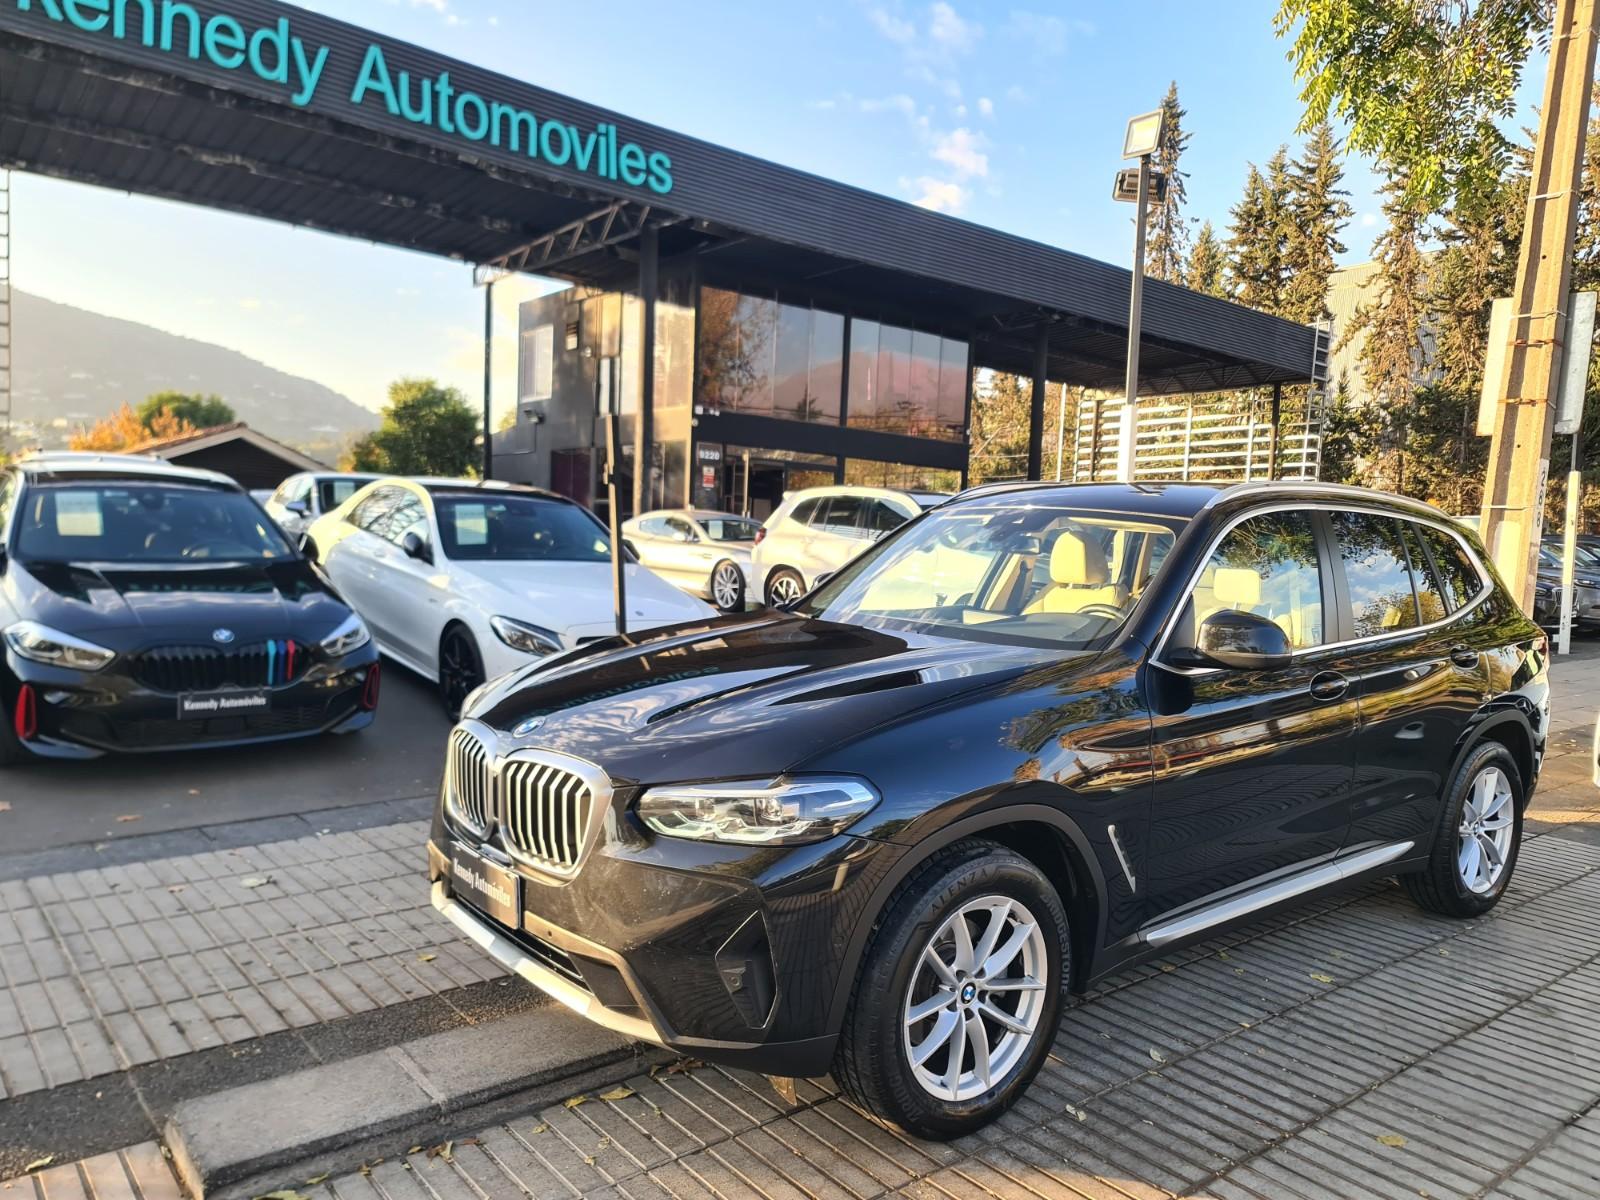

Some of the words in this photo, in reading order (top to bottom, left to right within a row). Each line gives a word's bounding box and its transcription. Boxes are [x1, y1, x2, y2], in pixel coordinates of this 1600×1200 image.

[17, 0, 329, 105] ennedy
[350, 44, 673, 194] Automoviles
[183, 698, 218, 711] Kennedy
[1039, 894, 1071, 994] BRIDGESTONE
